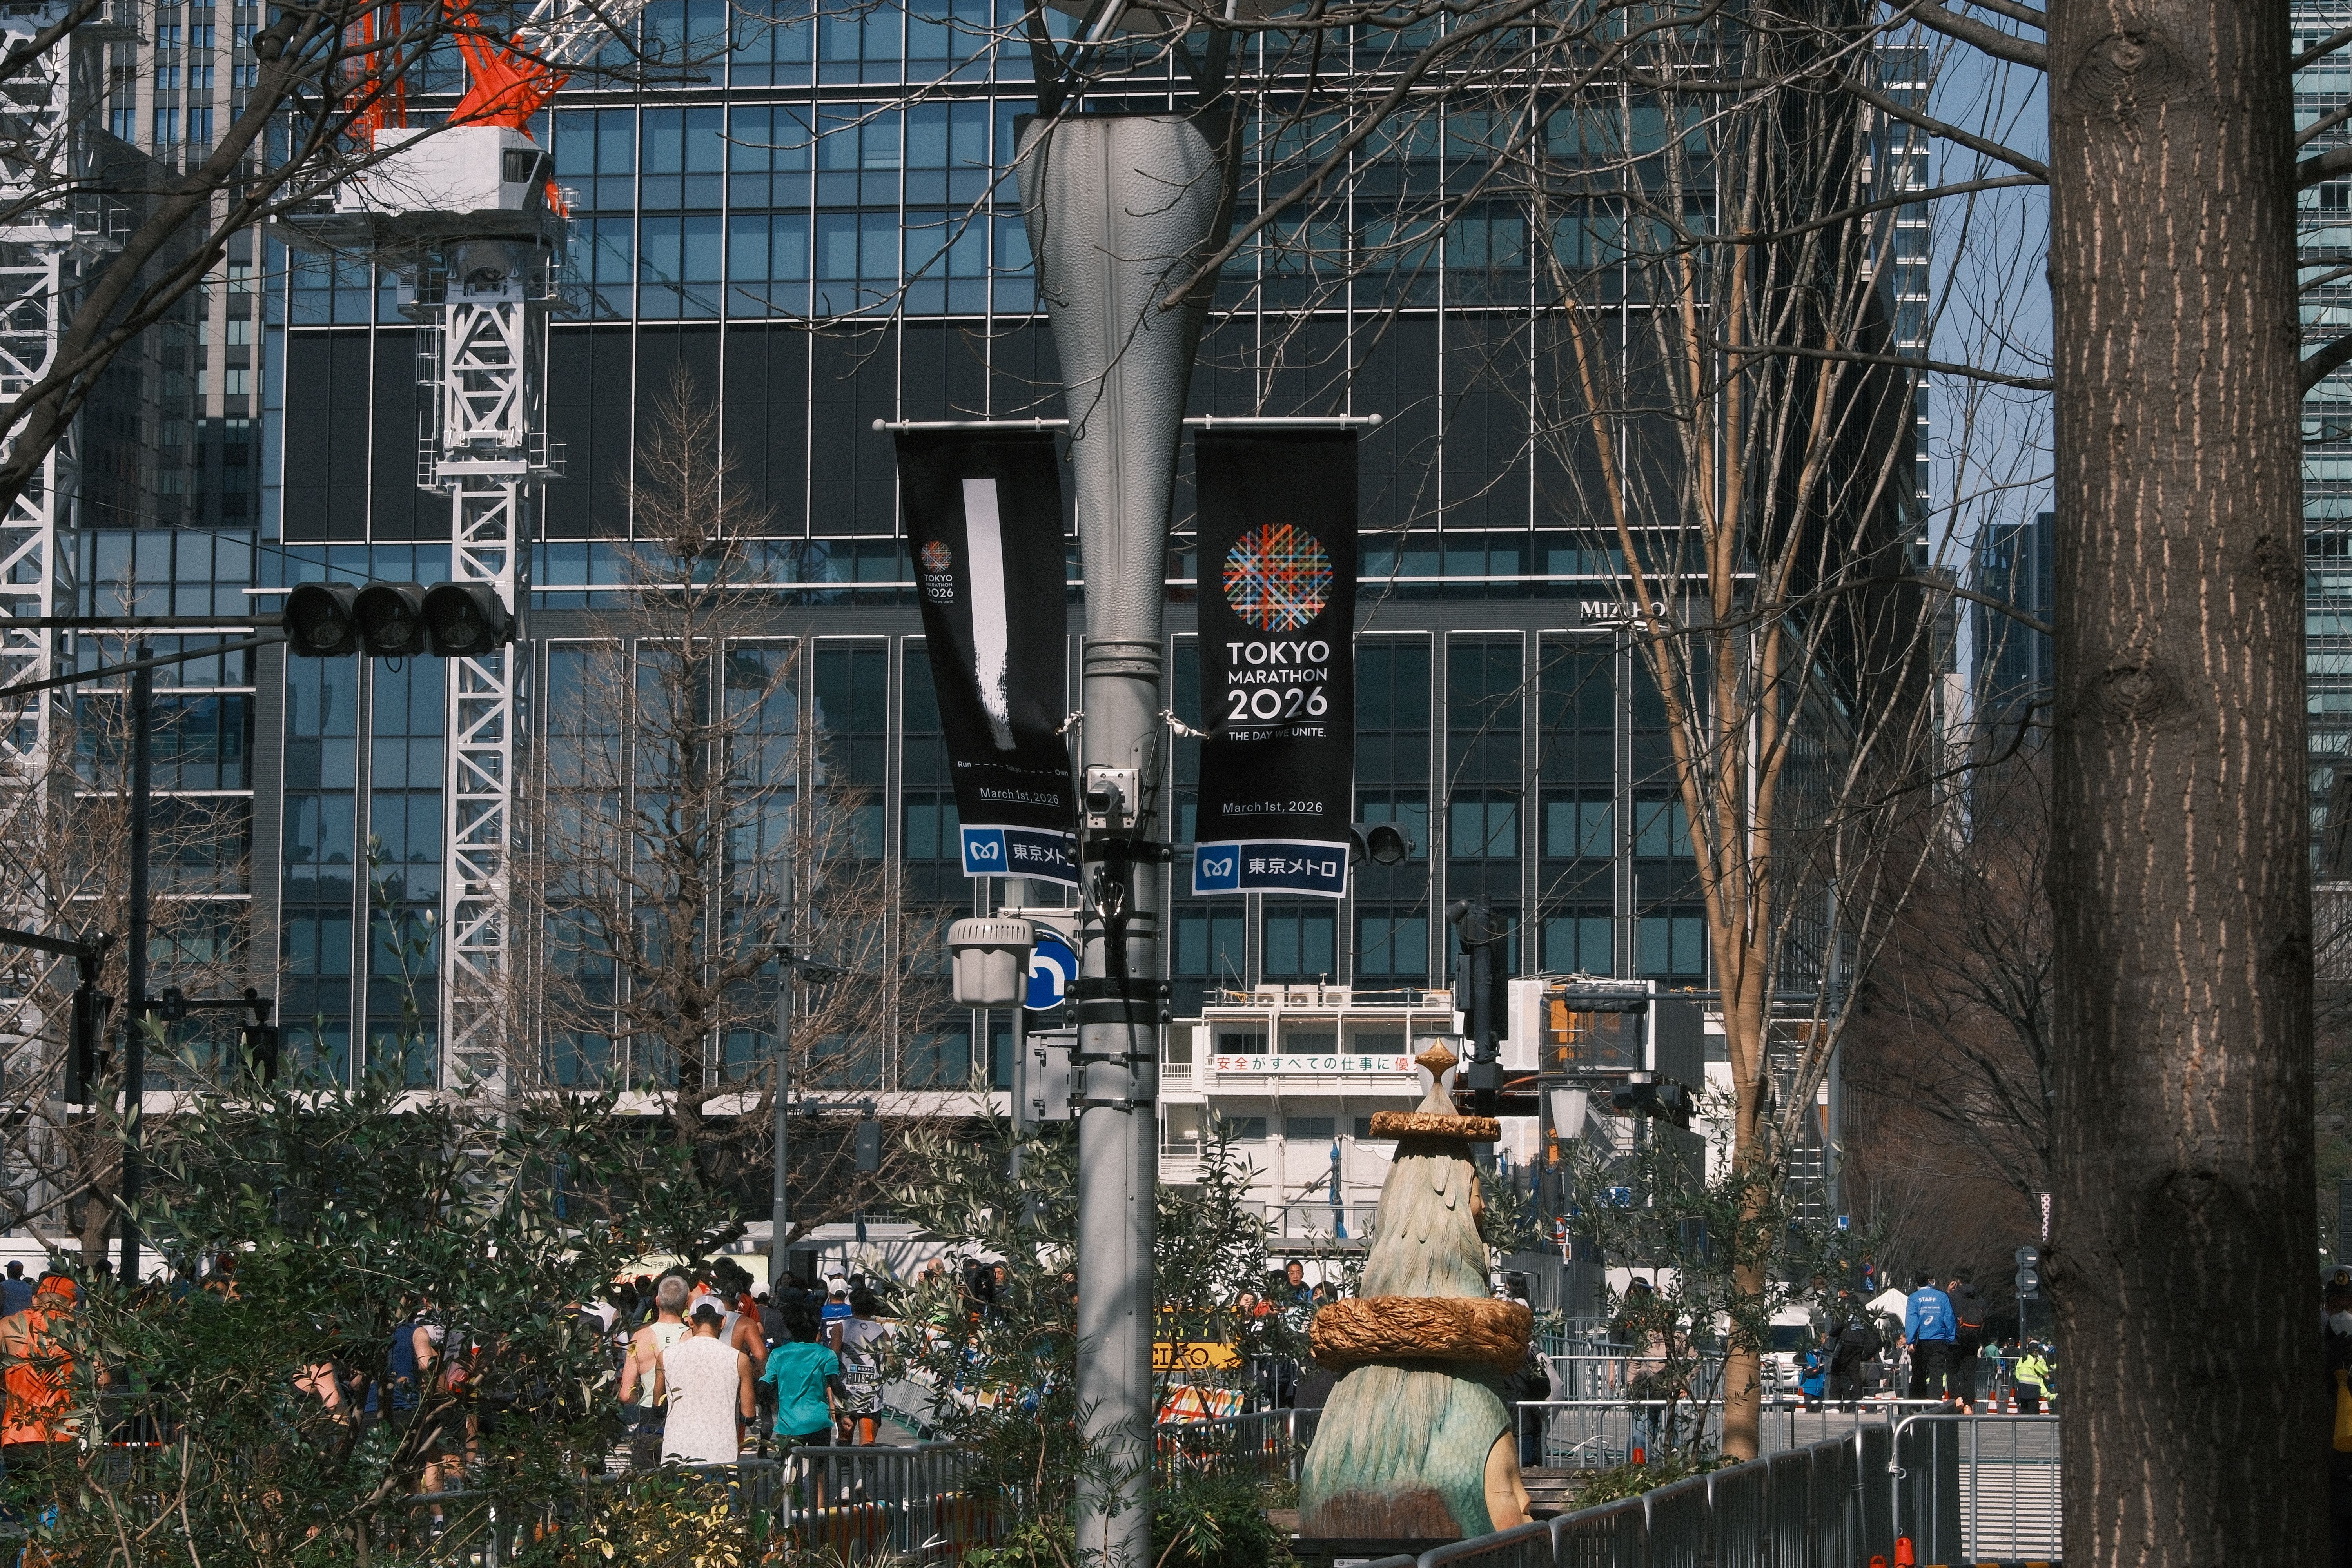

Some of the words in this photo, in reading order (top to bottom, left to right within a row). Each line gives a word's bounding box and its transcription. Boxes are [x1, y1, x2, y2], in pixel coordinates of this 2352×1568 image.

[926, 588, 953, 597] 2026
[1226, 640, 1329, 665] TOKYO
[1228, 668, 1327, 684] MARATHON
[1227, 686, 1327, 720] 2026
[1229, 731, 1249, 741] THE
[1253, 730, 1271, 740] DAY
[1275, 728, 1289, 738] WE
[1292, 727, 1327, 737] UNITE.
[980, 788, 1014, 799] March
[1016, 790, 1033, 802] 1st,
[1034, 792, 1059, 804] 2026
[1223, 802, 1261, 813] March
[1265, 801, 1285, 813] 1st,
[1289, 801, 1323, 813] 2026
[1013, 843, 1075, 867] 東京メト
[1248, 857, 1336, 877] 東京メトロ
[1217, 1056, 1418, 1071] 安全がすべての仕事に優
